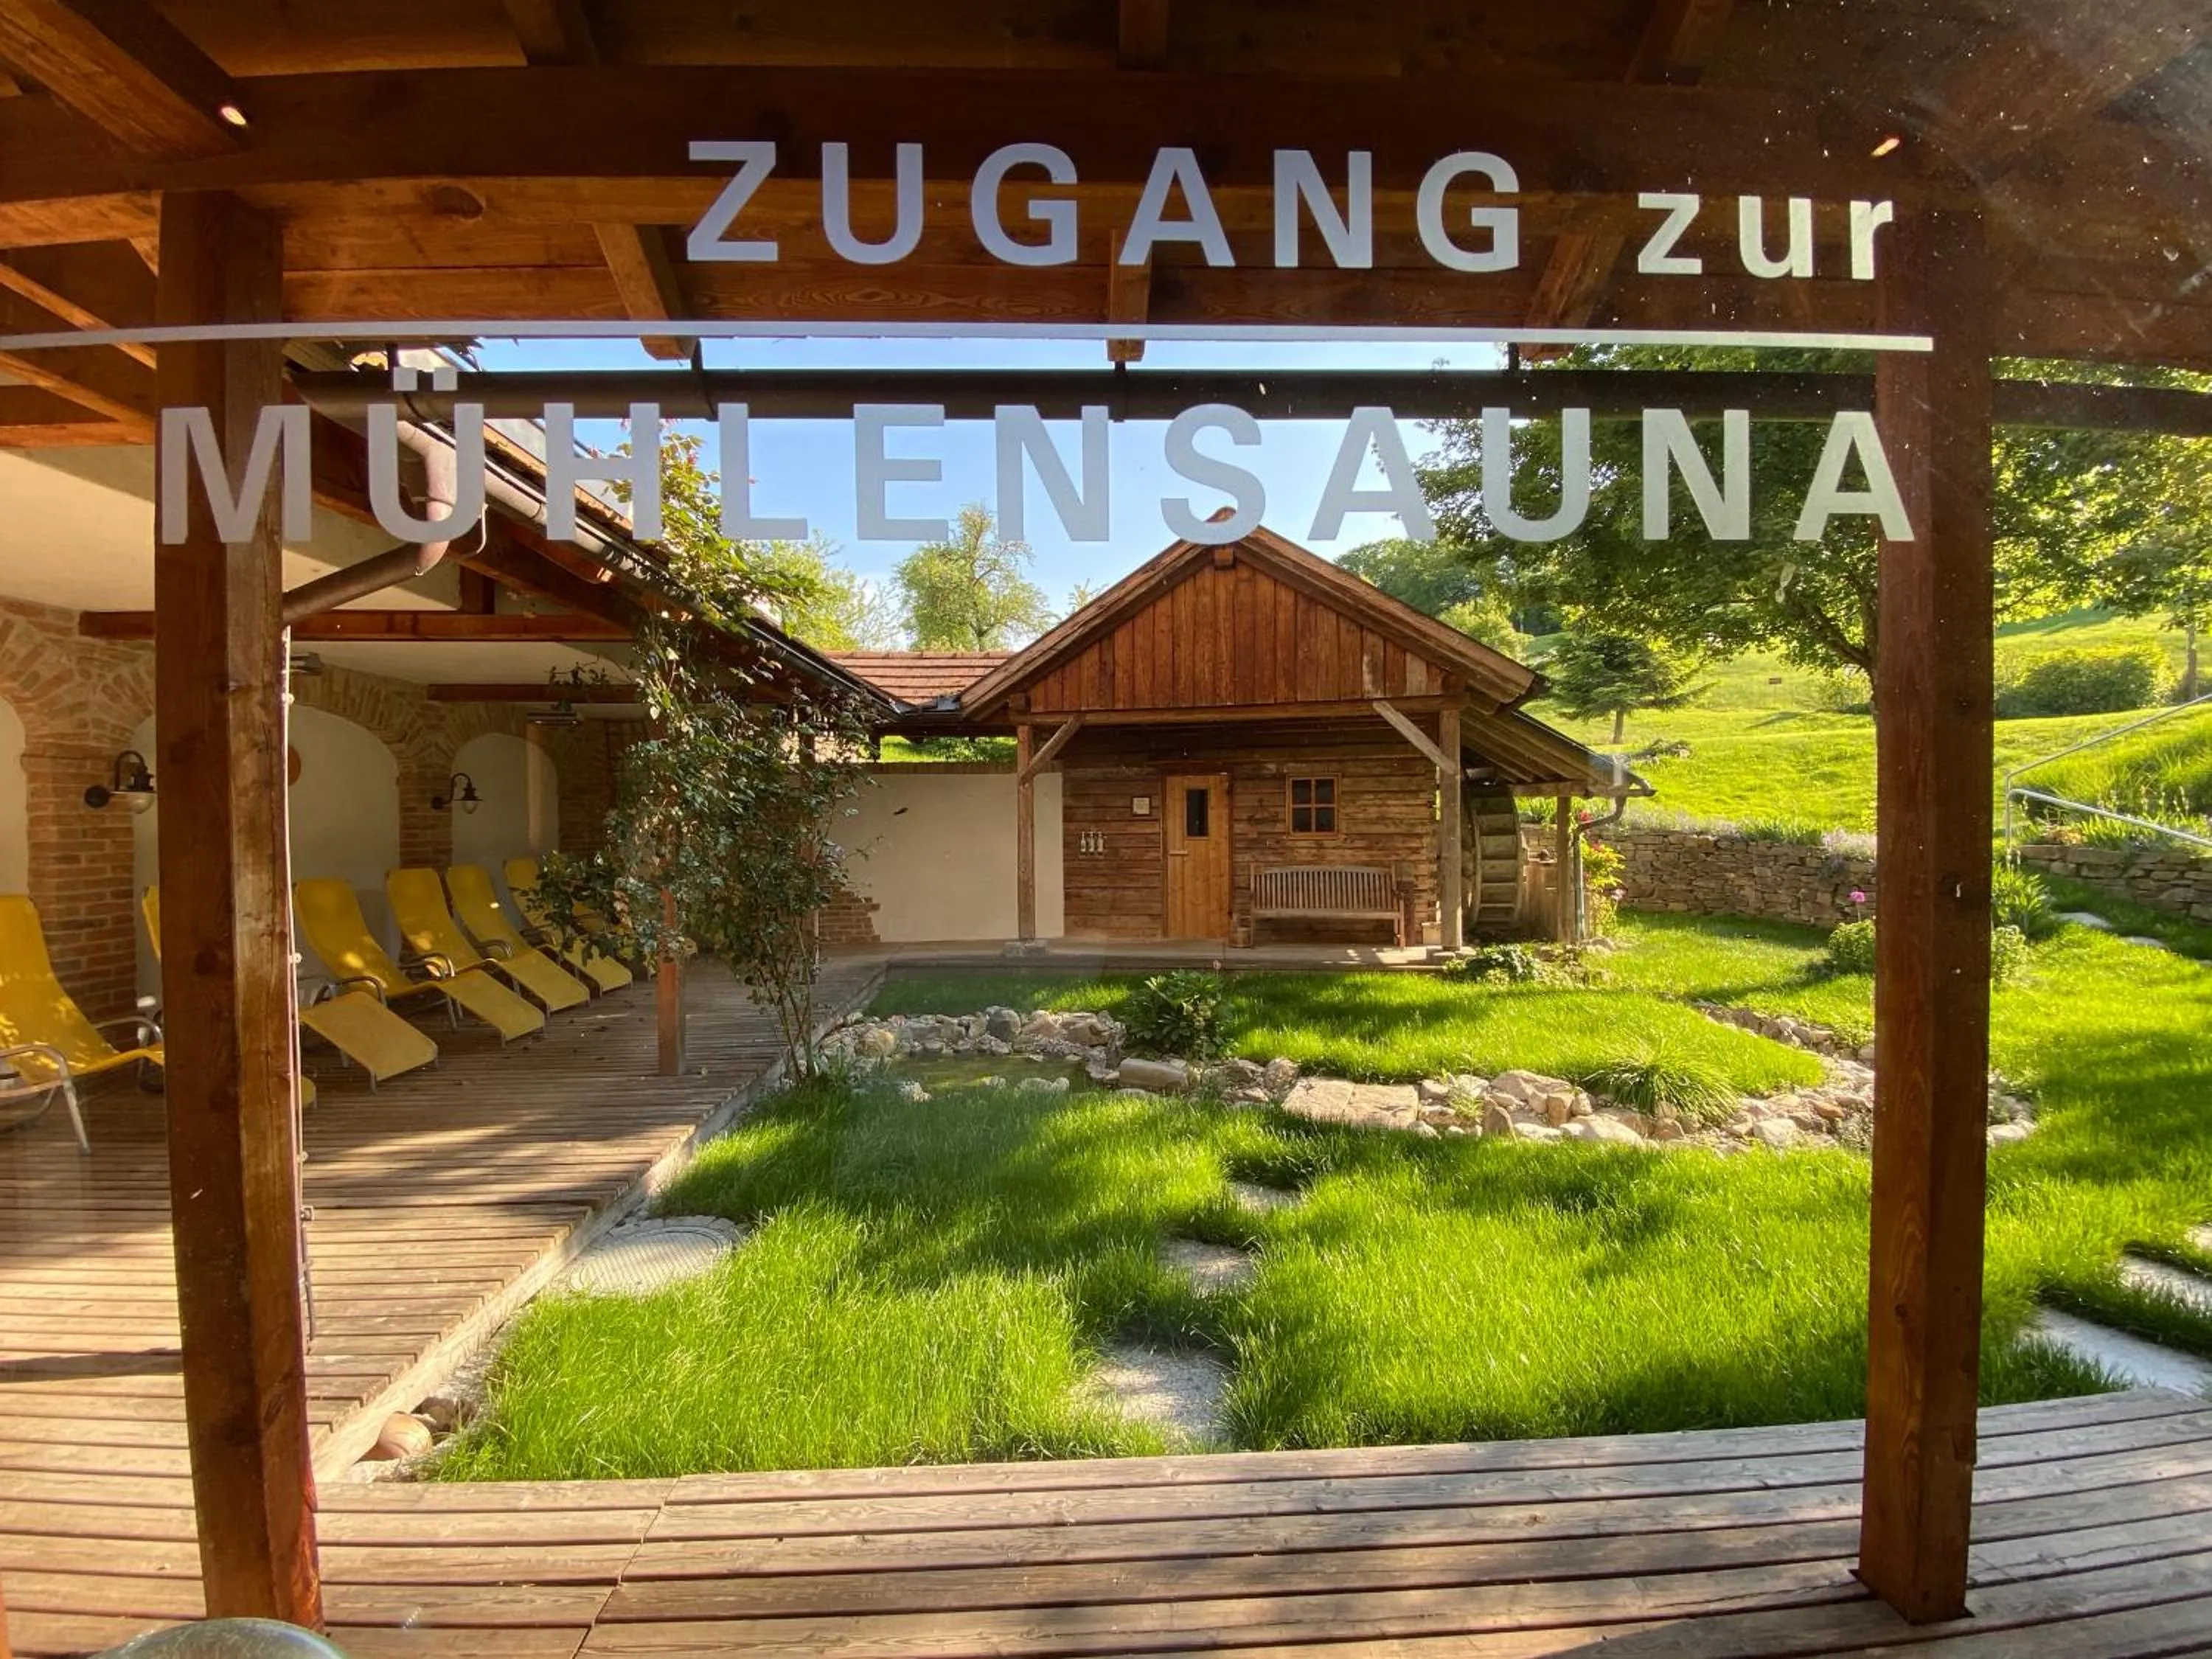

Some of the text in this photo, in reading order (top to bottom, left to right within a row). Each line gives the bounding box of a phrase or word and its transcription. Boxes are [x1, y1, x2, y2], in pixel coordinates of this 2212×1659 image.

[686, 141, 1893, 280] ZUGANG zur
[161, 367, 1915, 546] MÜHLENSAUNA
